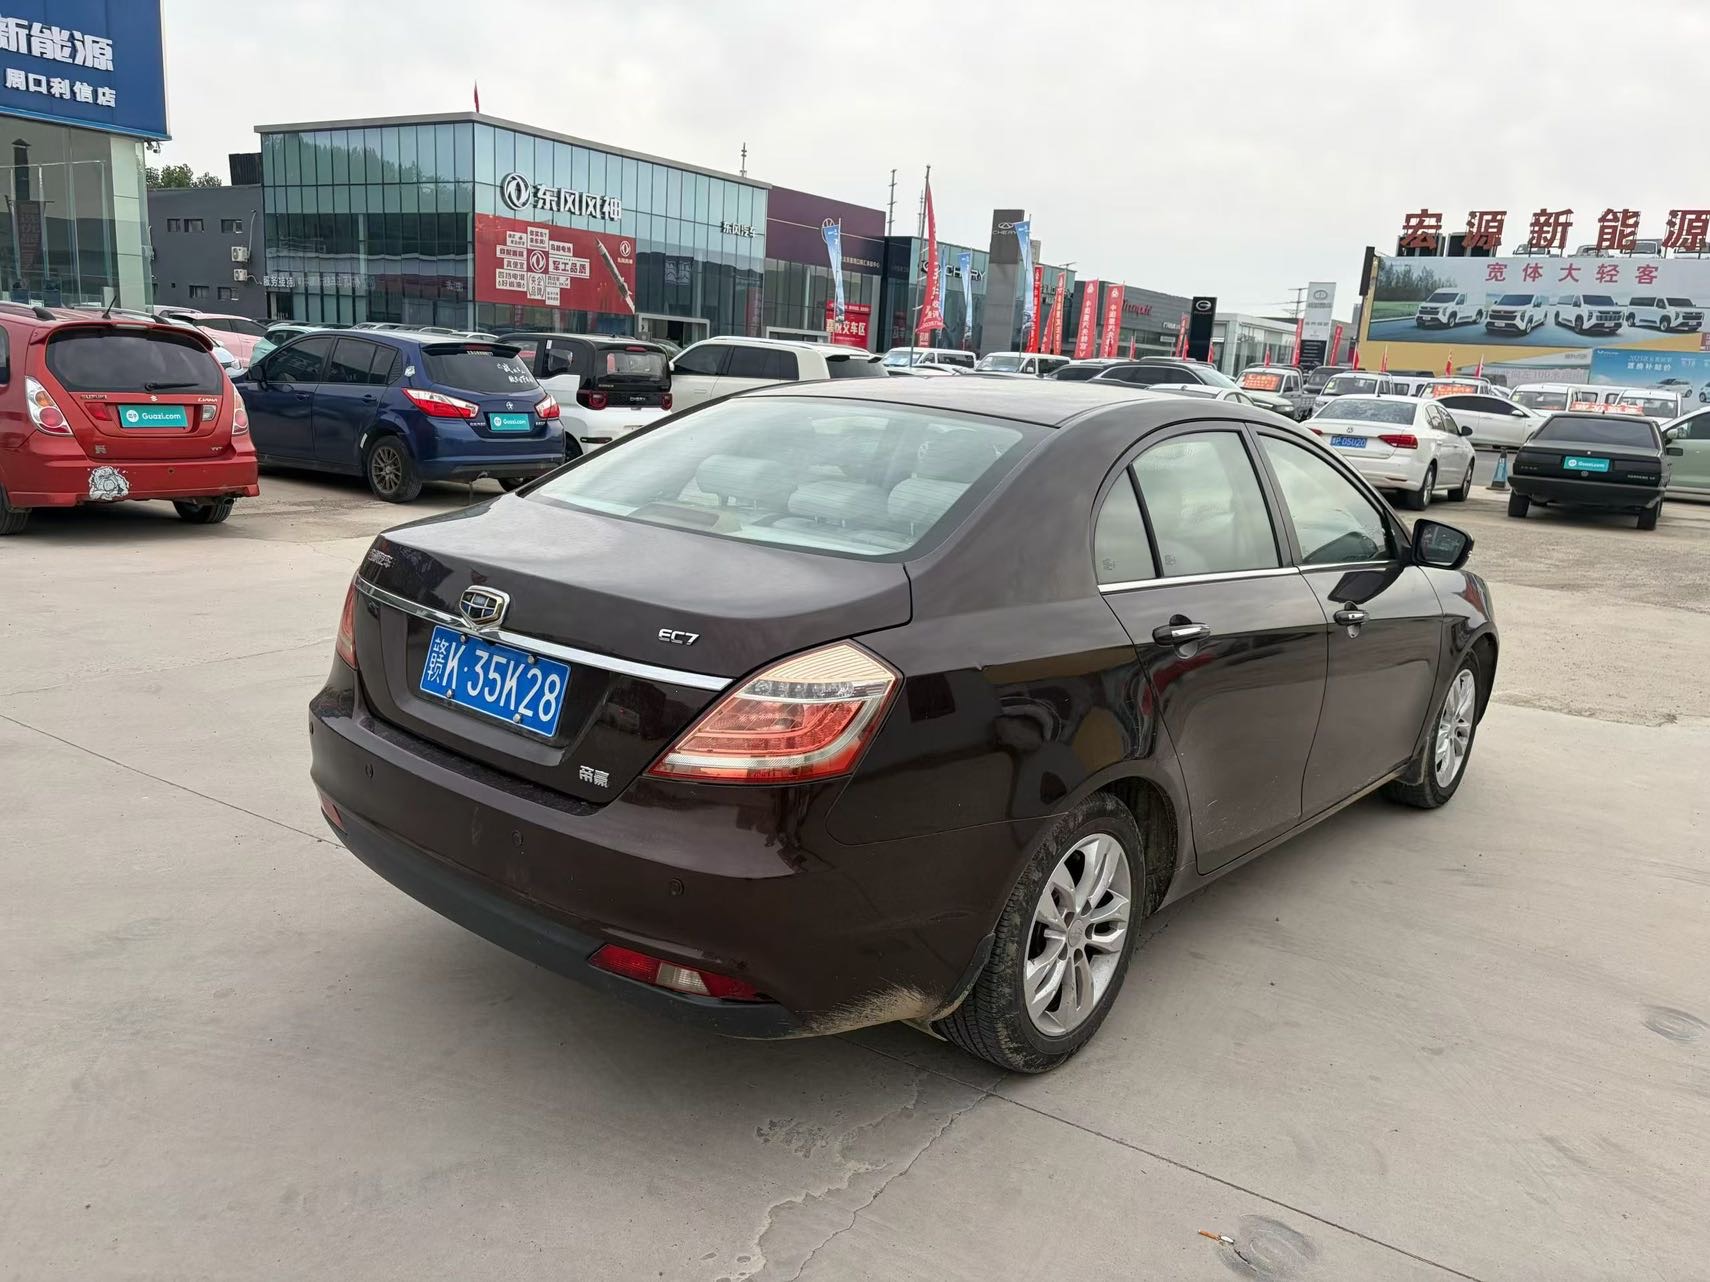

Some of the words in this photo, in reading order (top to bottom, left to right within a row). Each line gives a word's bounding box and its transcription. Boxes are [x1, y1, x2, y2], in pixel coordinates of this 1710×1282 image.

[5, 68, 116, 107] 周口利信店
[535, 184, 621, 220] 东风风神
[722, 221, 757, 238] 东风汽车
[1400, 207, 1710, 252] 宏源新能源
[552, 260, 587, 275] 军工品质
[1485, 262, 1658, 286] 宽体大轻客
[142, 412, 181, 420] Guazi.com
[658, 628, 699, 646] EC7
[579, 765, 609, 788] 帝豪
